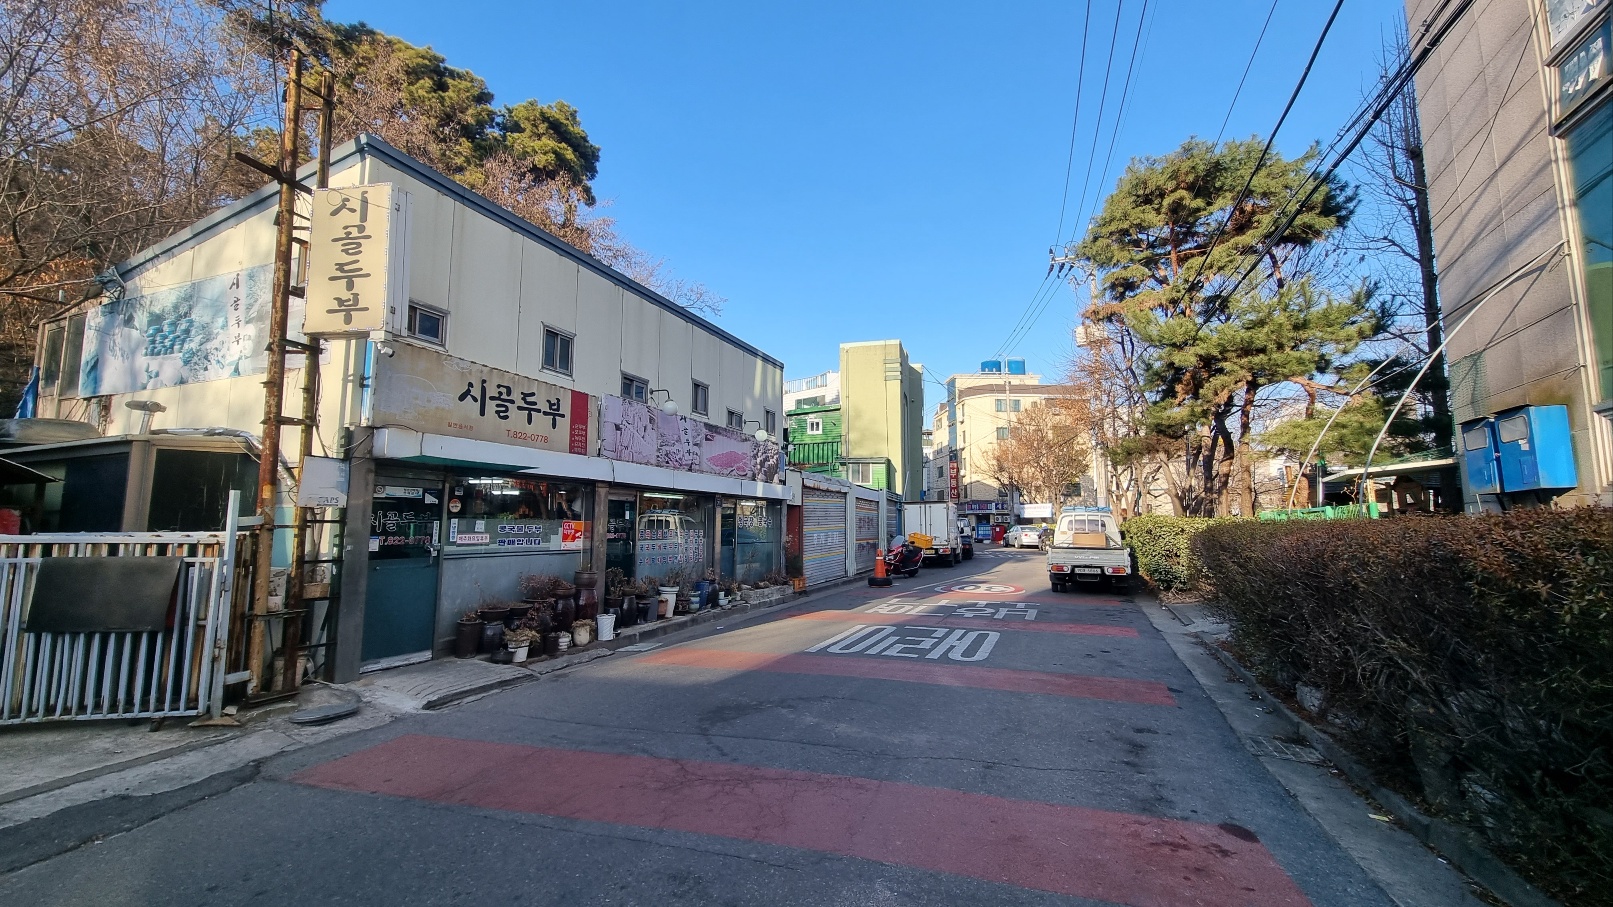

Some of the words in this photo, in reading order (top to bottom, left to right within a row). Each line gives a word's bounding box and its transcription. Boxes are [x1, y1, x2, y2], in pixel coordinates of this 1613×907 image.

[325, 190, 372, 325] 시골두부
[228, 272, 242, 345] 시골두부
[457, 378, 566, 430] 시골두부
[505, 429, 549, 443] T.822-0778
[525, 524, 543, 534] 두부
[865, 598, 1040, 621] 보호구역
[804, 624, 1001, 662] 어린이
